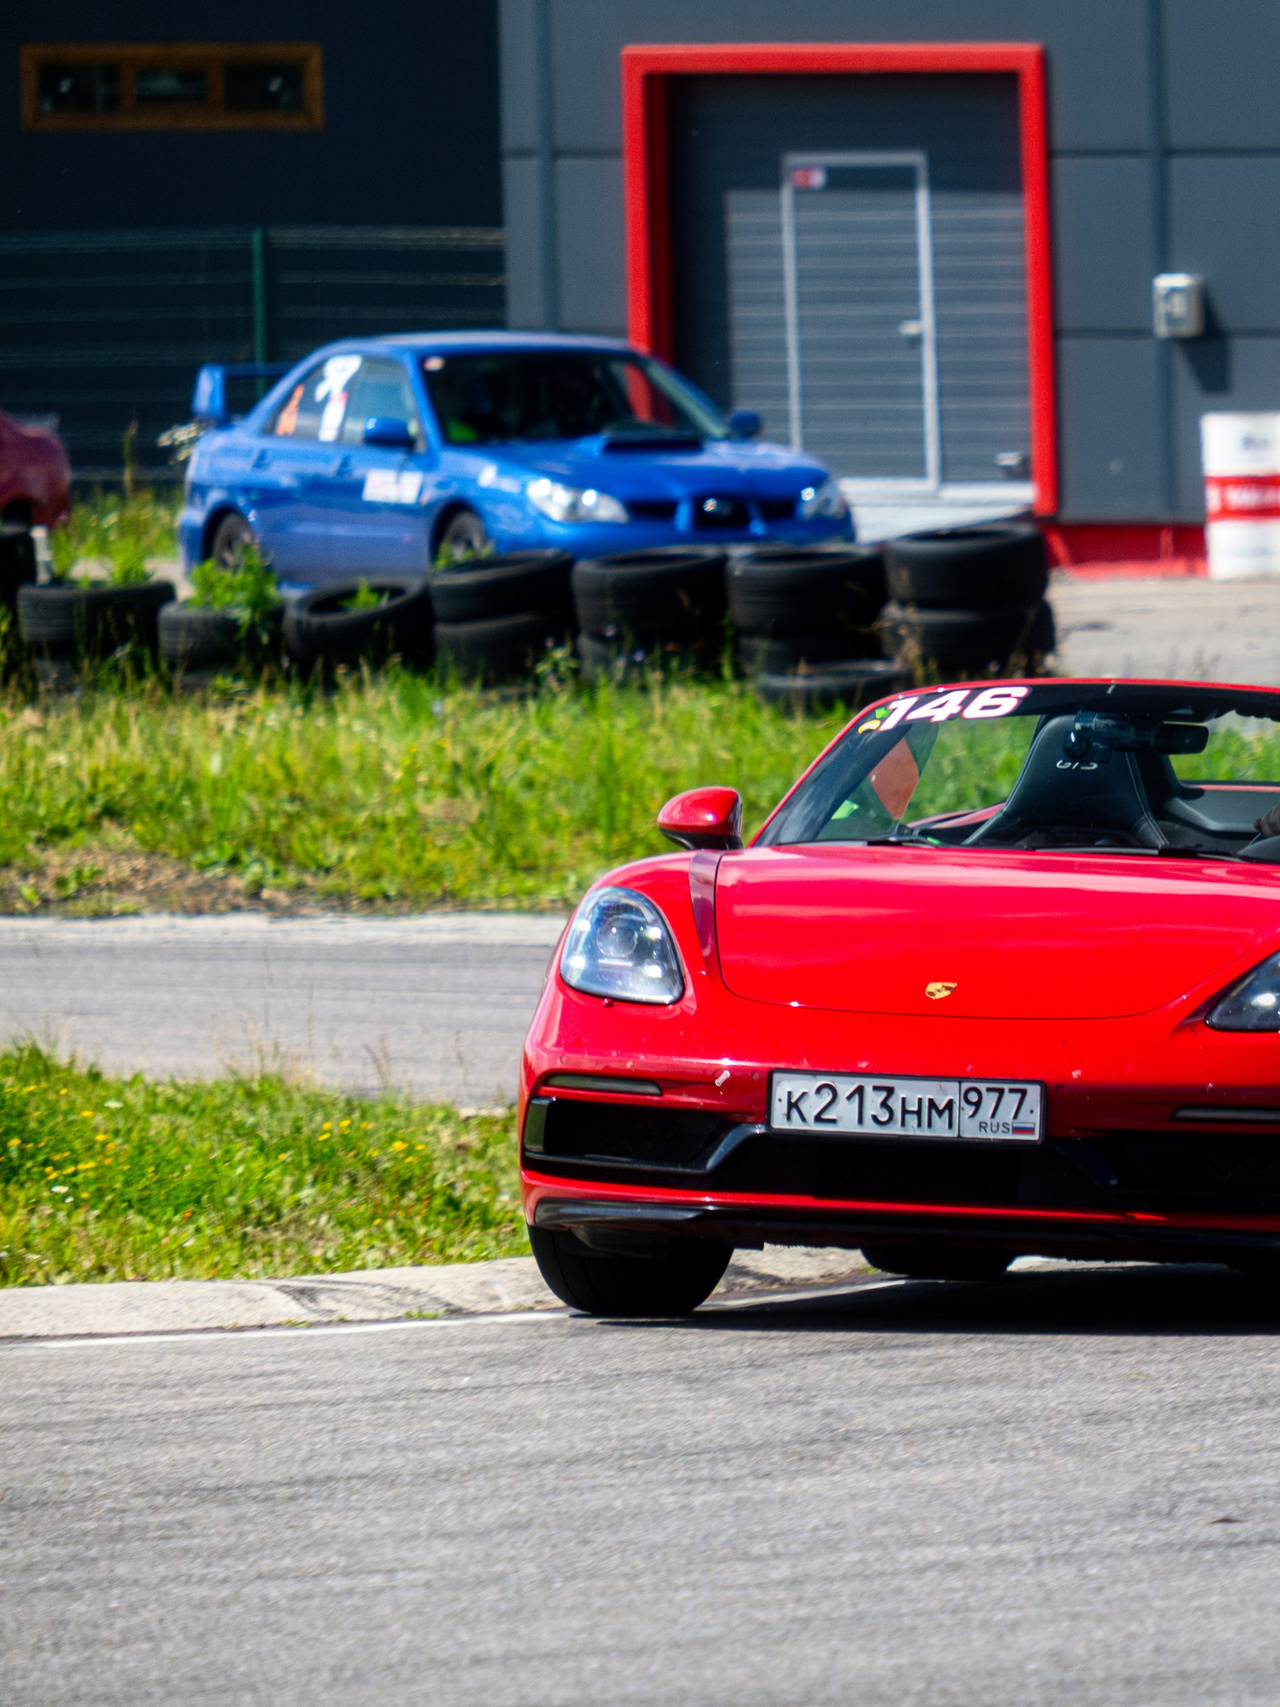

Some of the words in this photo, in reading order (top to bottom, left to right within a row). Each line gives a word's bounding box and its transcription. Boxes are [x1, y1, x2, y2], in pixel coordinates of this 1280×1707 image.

[877, 686, 1030, 731] 146
[962, 1087, 1028, 1119] 977
[979, 1121, 1011, 1134] RUS
